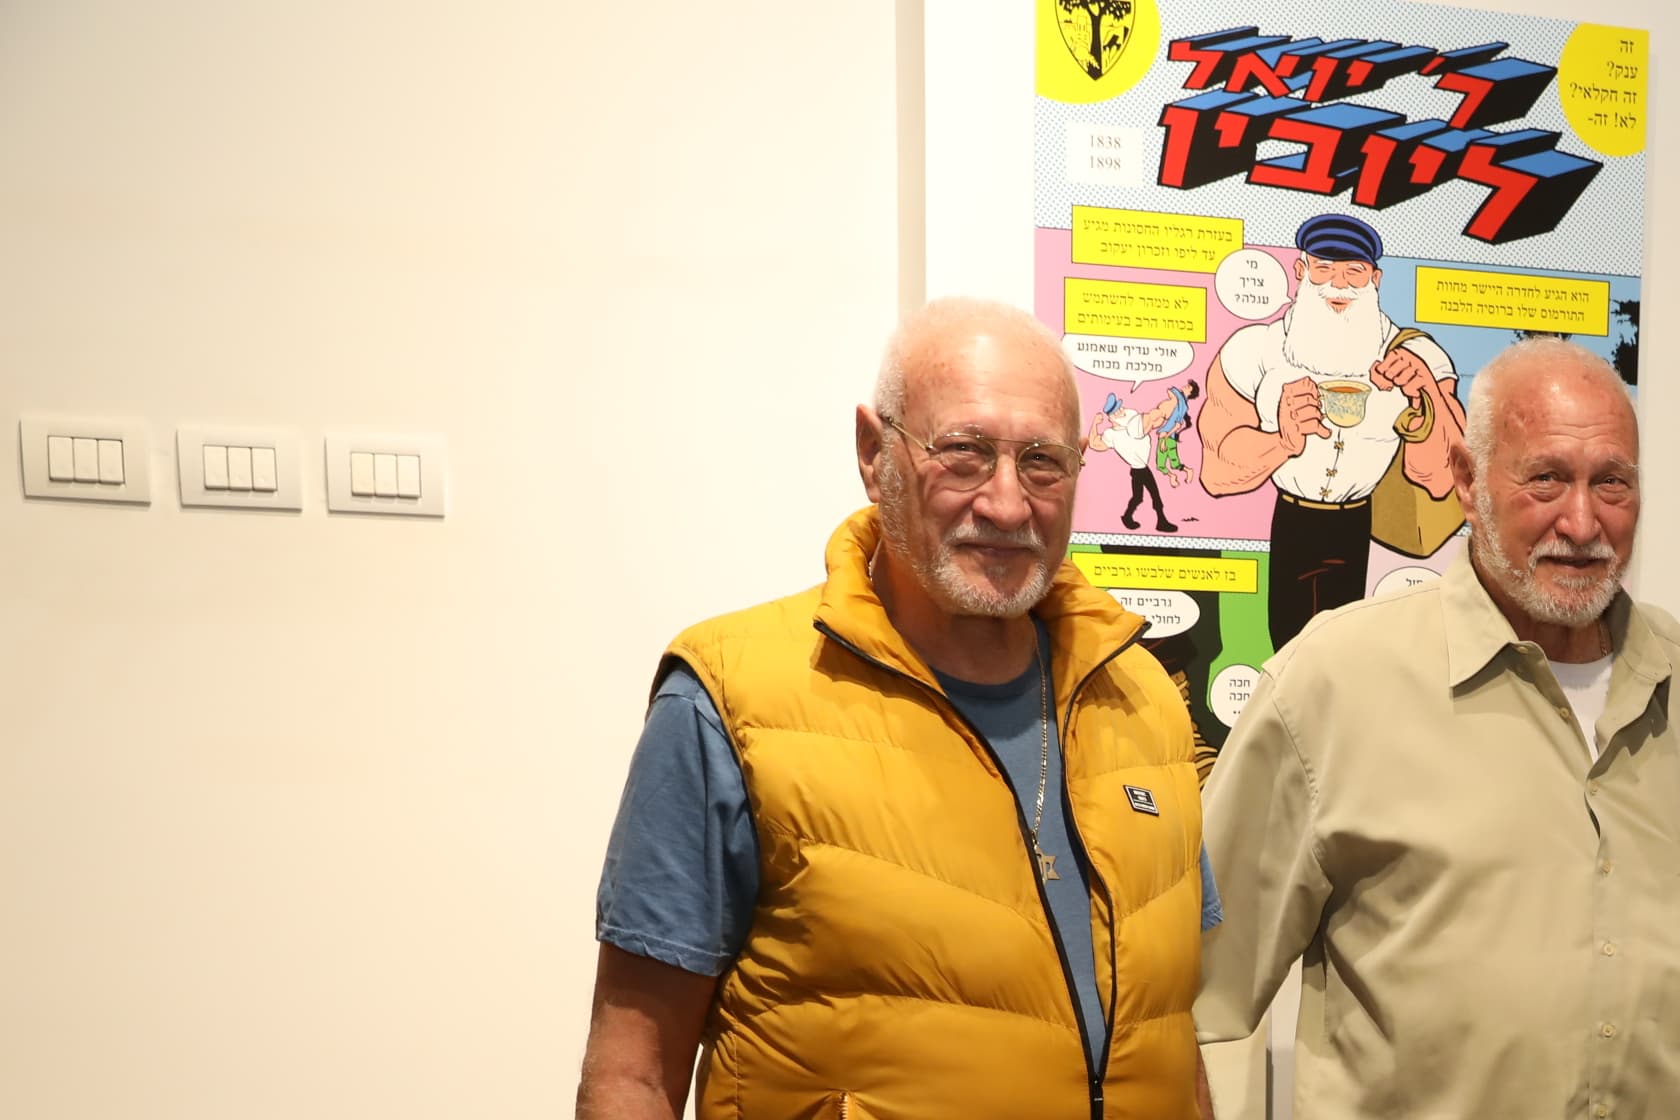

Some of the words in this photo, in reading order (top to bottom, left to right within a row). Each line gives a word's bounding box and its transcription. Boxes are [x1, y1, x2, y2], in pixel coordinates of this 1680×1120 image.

[1620, 40, 1634, 53] זה
[1169, 30, 1415, 104] יואל
[1607, 61, 1638, 80] ענק?
[1570, 82, 1618, 104] חקלאי?
[1624, 91, 1637, 104] זה
[1614, 112, 1637, 128] לא!
[1090, 135, 1121, 149] 1838
[1090, 156, 1121, 170] 1898
[1158, 92, 1590, 244] ליובין
[1084, 218, 1109, 232] מגיע
[1113, 223, 1159, 236] החסונות
[1164, 225, 1193, 239] רגליו
[1198, 228, 1232, 242] בעזרת
[1101, 241, 1132, 256] יעקוב
[1175, 246, 1197, 260] ליפו
[1202, 249, 1215, 262] עד
[1246, 259, 1258, 269] מי
[1239, 277, 1264, 289] צריך
[1437, 279, 1467, 293] מחוות
[1472, 283, 1502, 296] היישר
[1083, 291, 1133, 305] להשתמש
[1507, 284, 1541, 299] לחדרה
[1545, 288, 1567, 301] הגיע
[1571, 290, 1589, 302] הוא
[1140, 296, 1169, 309] ממהר
[1174, 297, 1188, 309] לא
[1441, 299, 1473, 313] הלבנה
[1477, 302, 1513, 317] ברוסיה
[1518, 303, 1537, 318] שלו
[1541, 308, 1584, 322] התורמוס
[1078, 311, 1130, 327] בעימותים
[1136, 316, 1158, 328] הרב
[1164, 318, 1193, 331] בכוחו
[1078, 341, 1117, 354] שאמנע
[1124, 343, 1150, 357] עדיף
[1155, 344, 1177, 358] אולי
[1093, 358, 1120, 370] מכות
[1126, 360, 1162, 372] מללכת
[1094, 565, 1132, 577] גרביים
[1136, 565, 1175, 579] שלבשו
[1179, 568, 1221, 580] לאנשים
[1225, 570, 1236, 581] בז
[1121, 597, 1133, 606] זה
[1137, 598, 1172, 607] גרביים
[1152, 614, 1180, 625] לחולי
[1230, 678, 1250, 688] חכה
